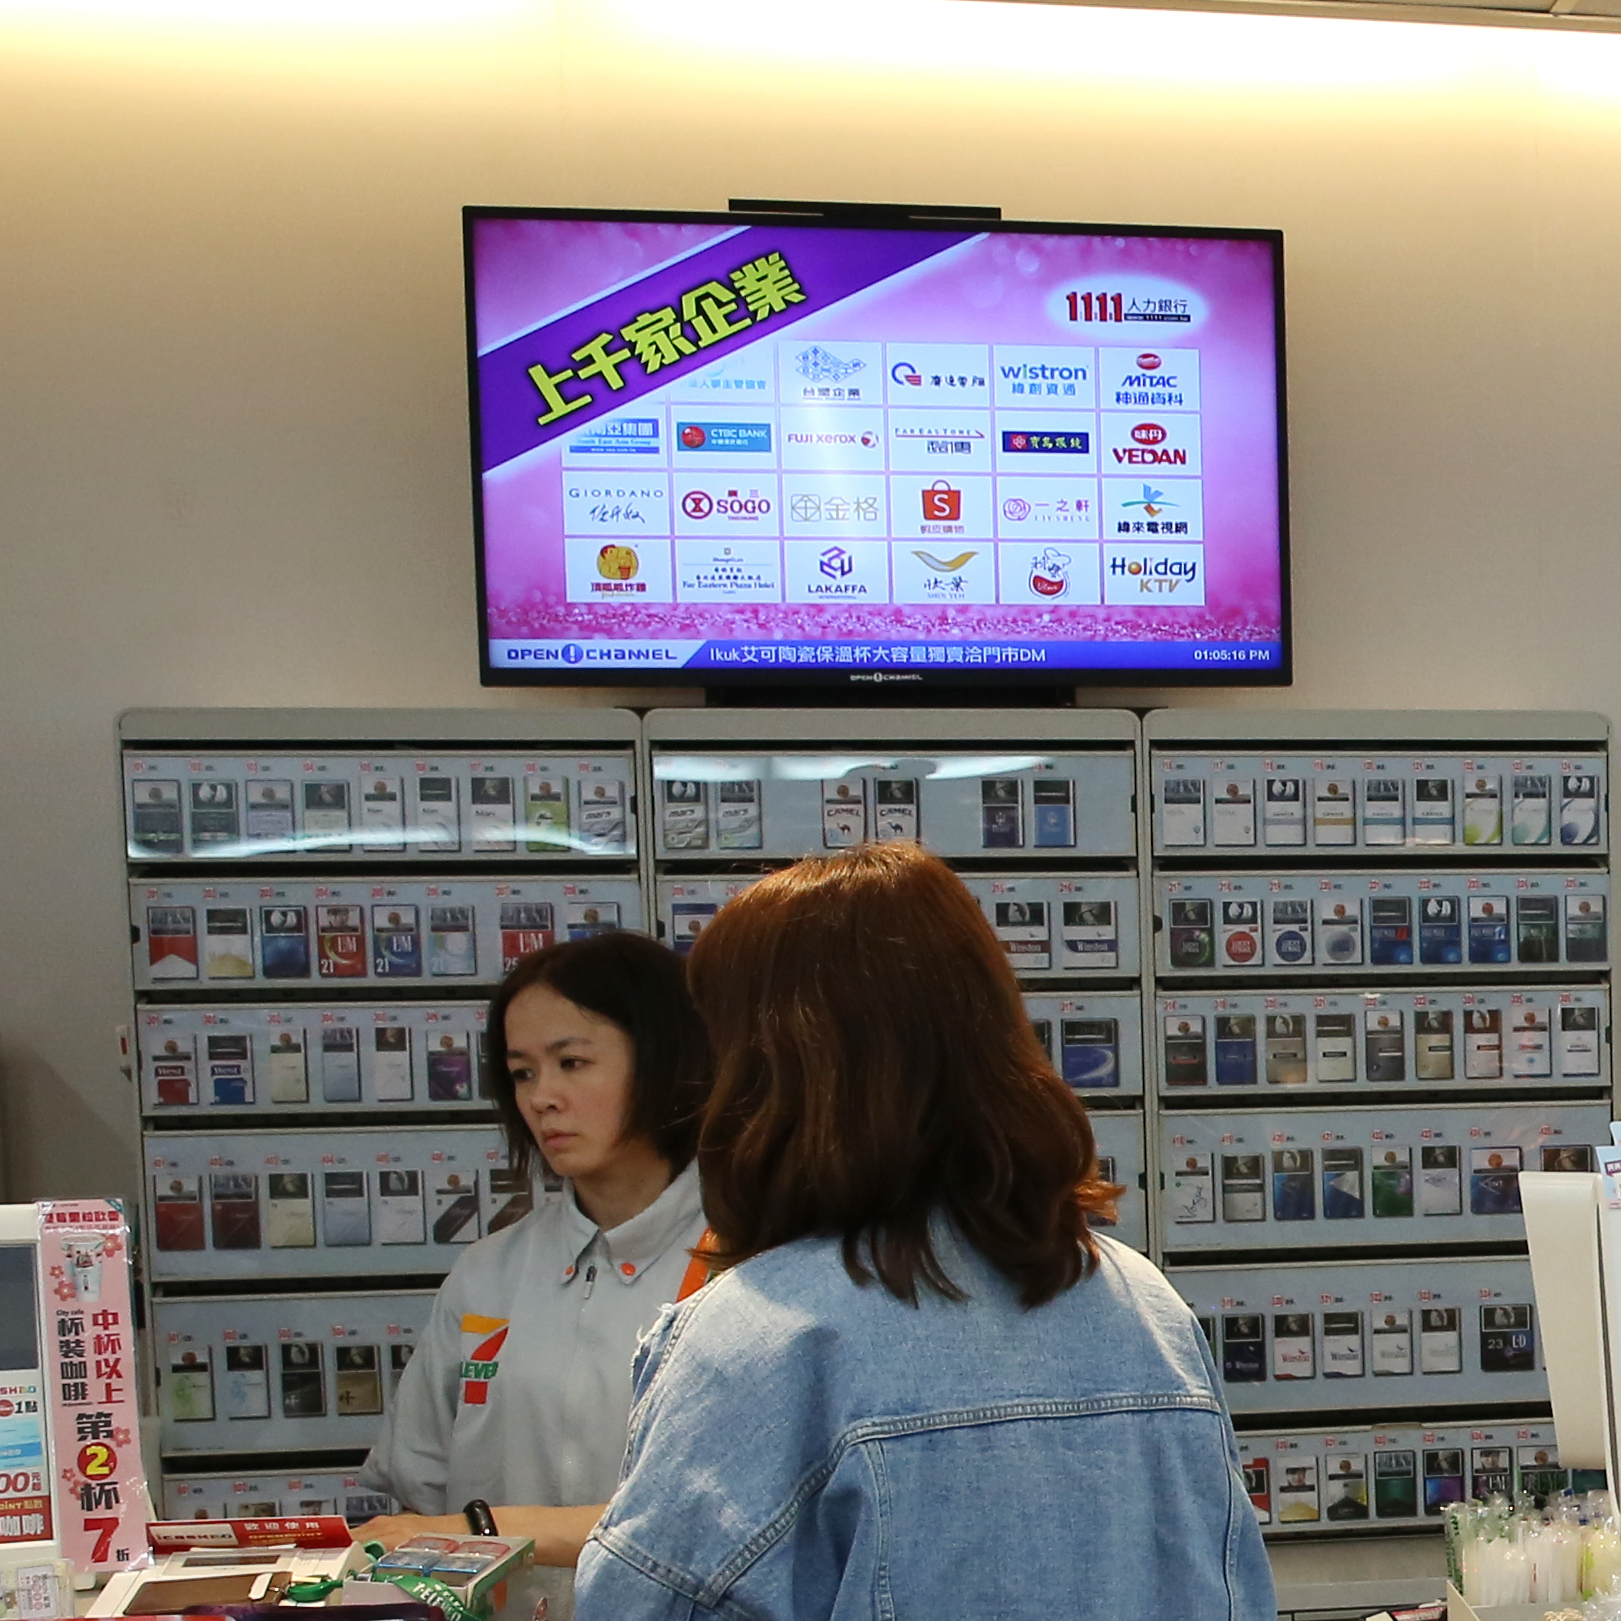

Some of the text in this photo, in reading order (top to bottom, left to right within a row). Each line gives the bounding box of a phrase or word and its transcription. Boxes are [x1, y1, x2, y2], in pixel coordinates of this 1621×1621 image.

[1127, 298, 1189, 314] 人力銀行
[526, 250, 807, 427] 上千家企業
[1000, 364, 1088, 381] wistron
[739, 429, 768, 439] BANK
[787, 433, 813, 444] FUJI
[1112, 448, 1187, 466] VEDAN
[568, 487, 664, 498] GIORDANO
[716, 499, 771, 514] SOGO
[825, 496, 879, 522] 金格
[1034, 499, 1090, 513] 一之軒
[1117, 521, 1189, 535] 緯來電視網
[1110, 557, 1197, 582] Holiday
[807, 584, 868, 594] LAKAFFA
[1139, 578, 1182, 593] KTV
[1194, 649, 1271, 661] 01:05:16 PM
[56, 1317, 88, 1402] 杯裝咖啡
[92, 1309, 125, 1405] 中杯以上
